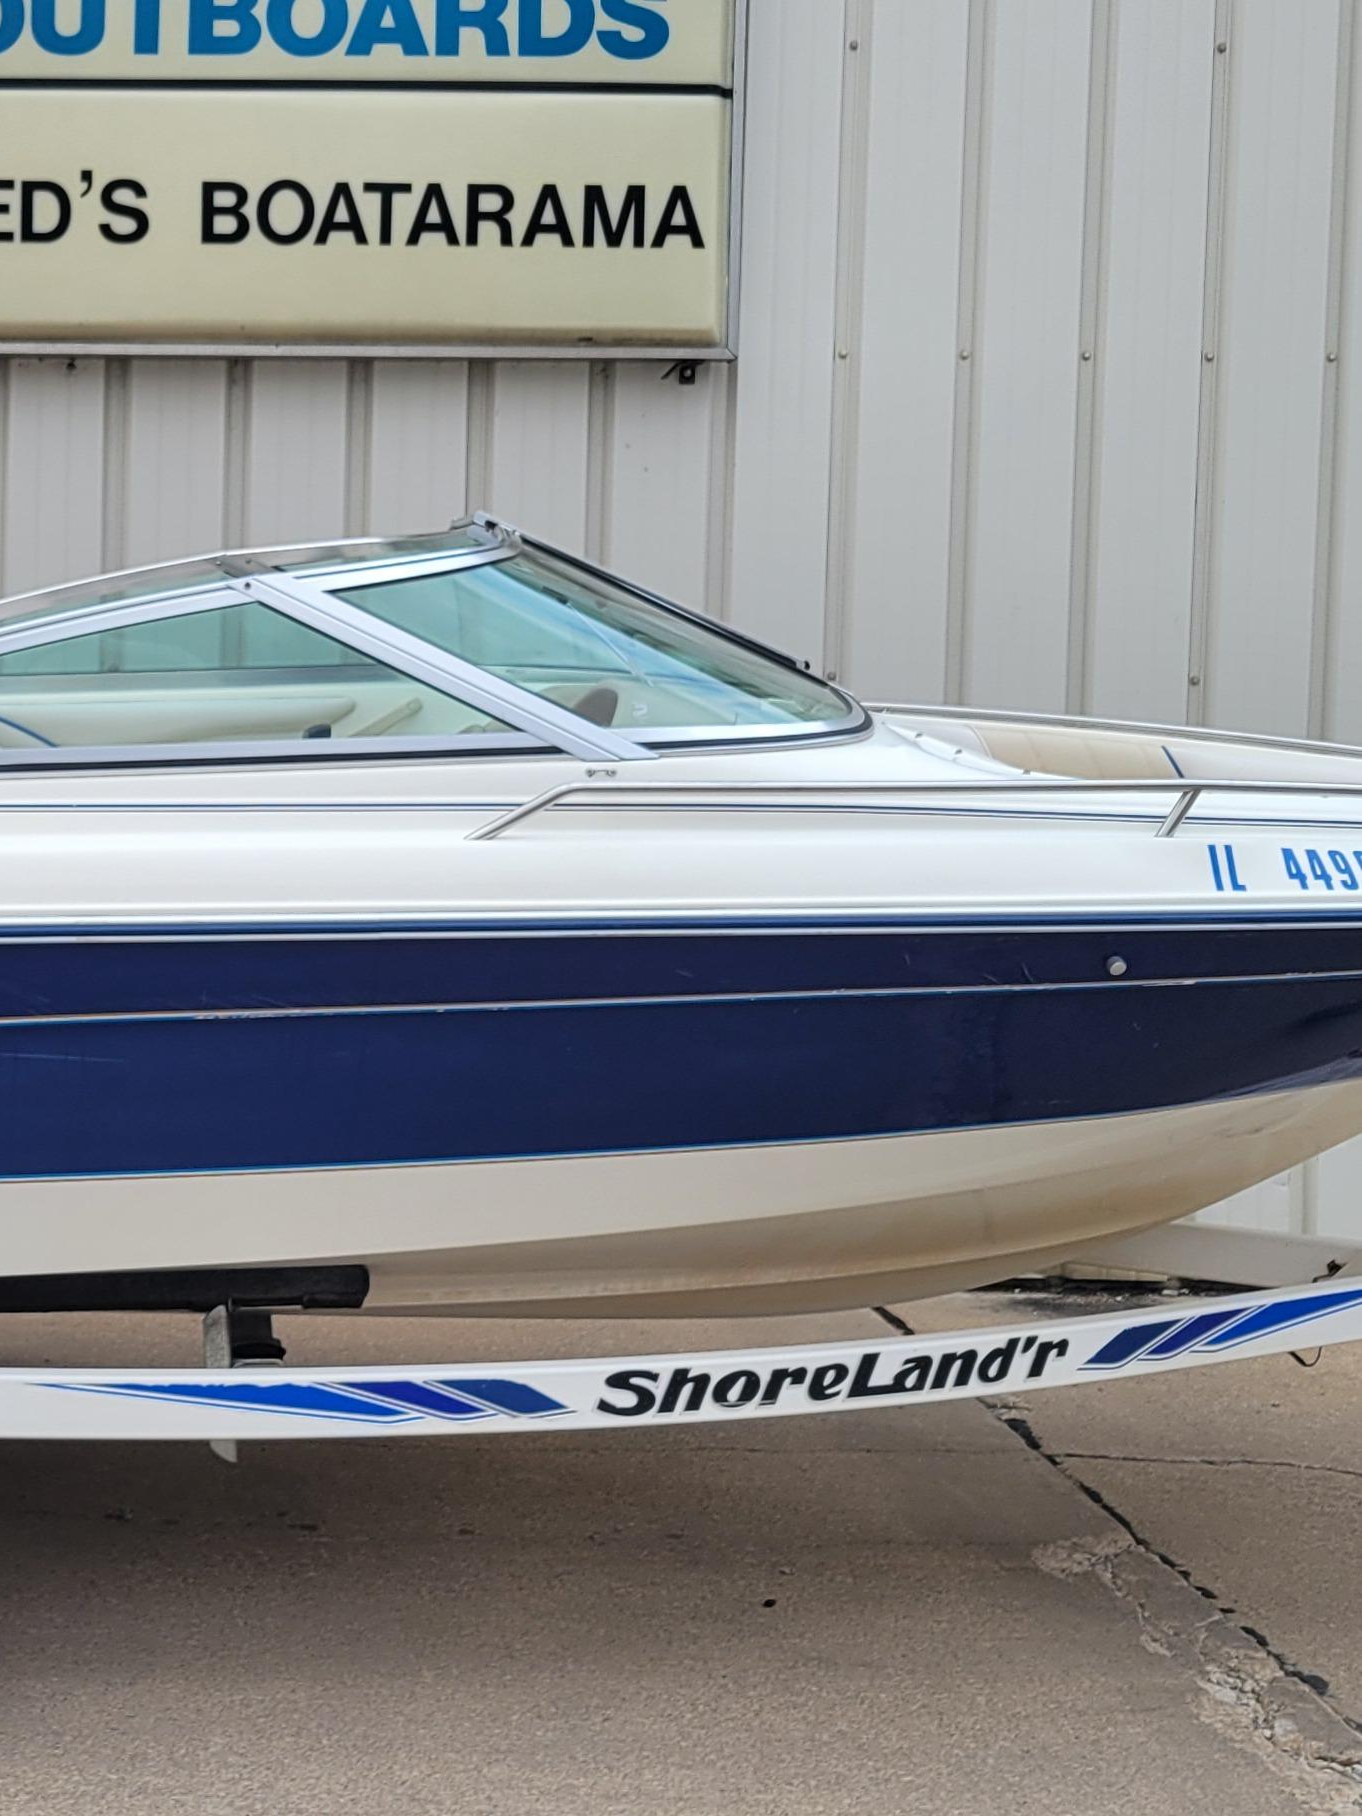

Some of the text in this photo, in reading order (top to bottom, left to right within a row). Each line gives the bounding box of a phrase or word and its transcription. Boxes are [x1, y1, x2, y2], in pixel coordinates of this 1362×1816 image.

[200, 179, 706, 250] BOATARAMA
[1207, 844, 1362, 892] IL 449
[596, 1335, 1070, 1416] ShoreLand'r
